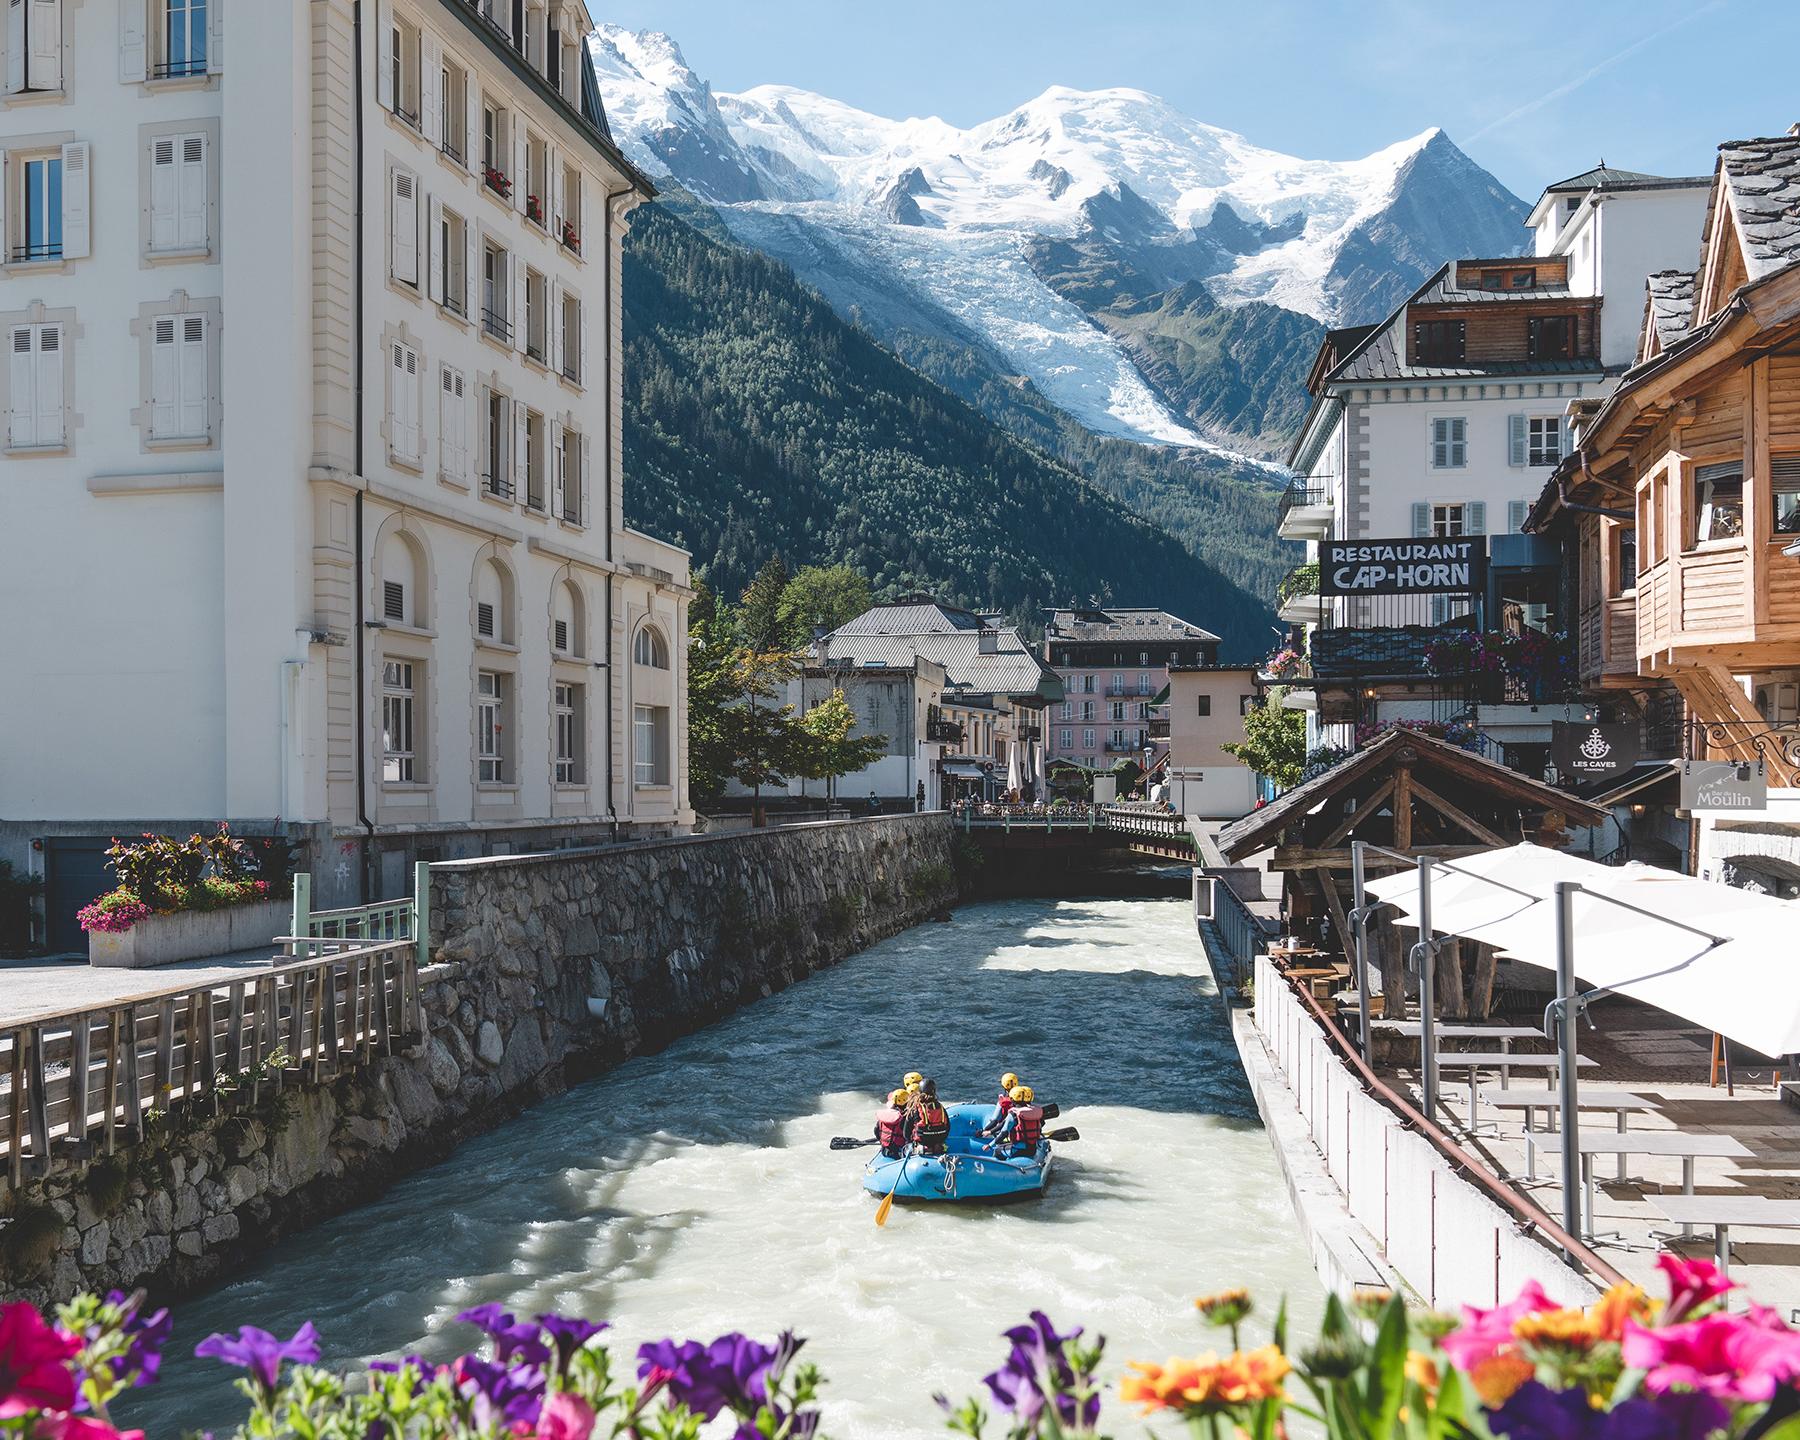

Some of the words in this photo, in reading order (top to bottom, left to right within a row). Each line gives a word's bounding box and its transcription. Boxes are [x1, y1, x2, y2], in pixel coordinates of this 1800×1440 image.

[1332, 543, 1472, 563] RESTAURANT
[1333, 563, 1469, 589] CAP-HORN
[1697, 792, 1752, 806] Moulin
